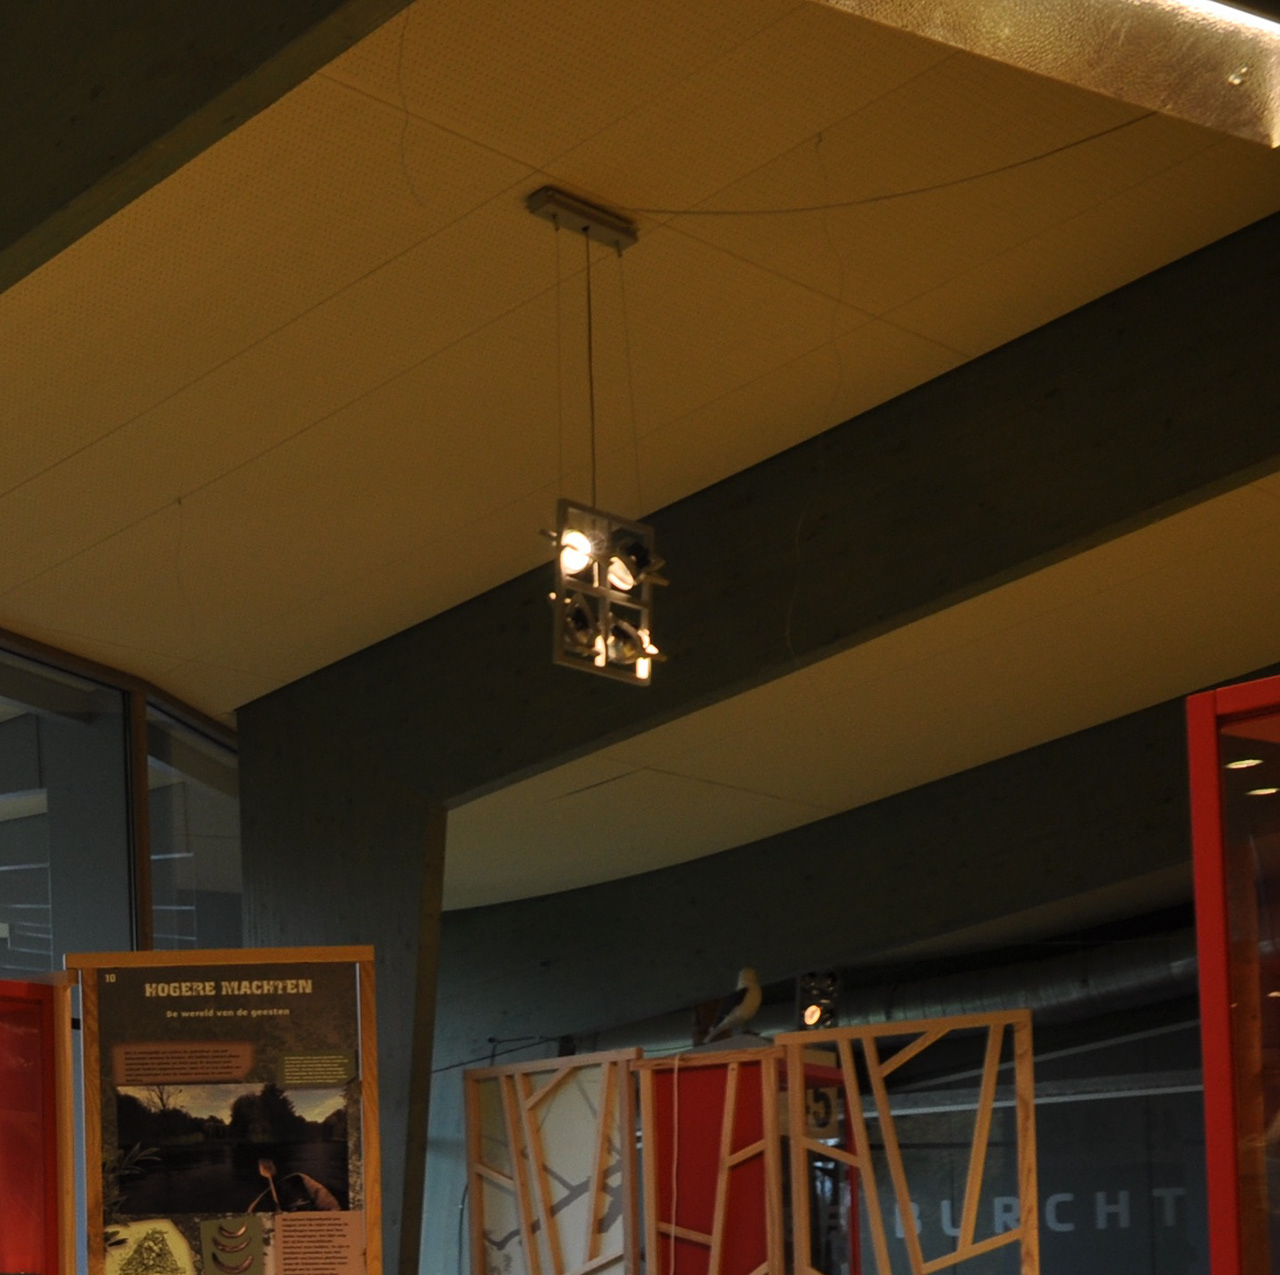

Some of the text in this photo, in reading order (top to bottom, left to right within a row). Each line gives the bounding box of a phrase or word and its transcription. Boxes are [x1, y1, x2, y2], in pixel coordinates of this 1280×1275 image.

[105, 974, 116, 982] 10
[144, 979, 313, 997] HOGERE MACHTEN
[166, 1008, 290, 1018] De wereld van de geesten
[895, 1187, 1187, 1239] BURCHT
